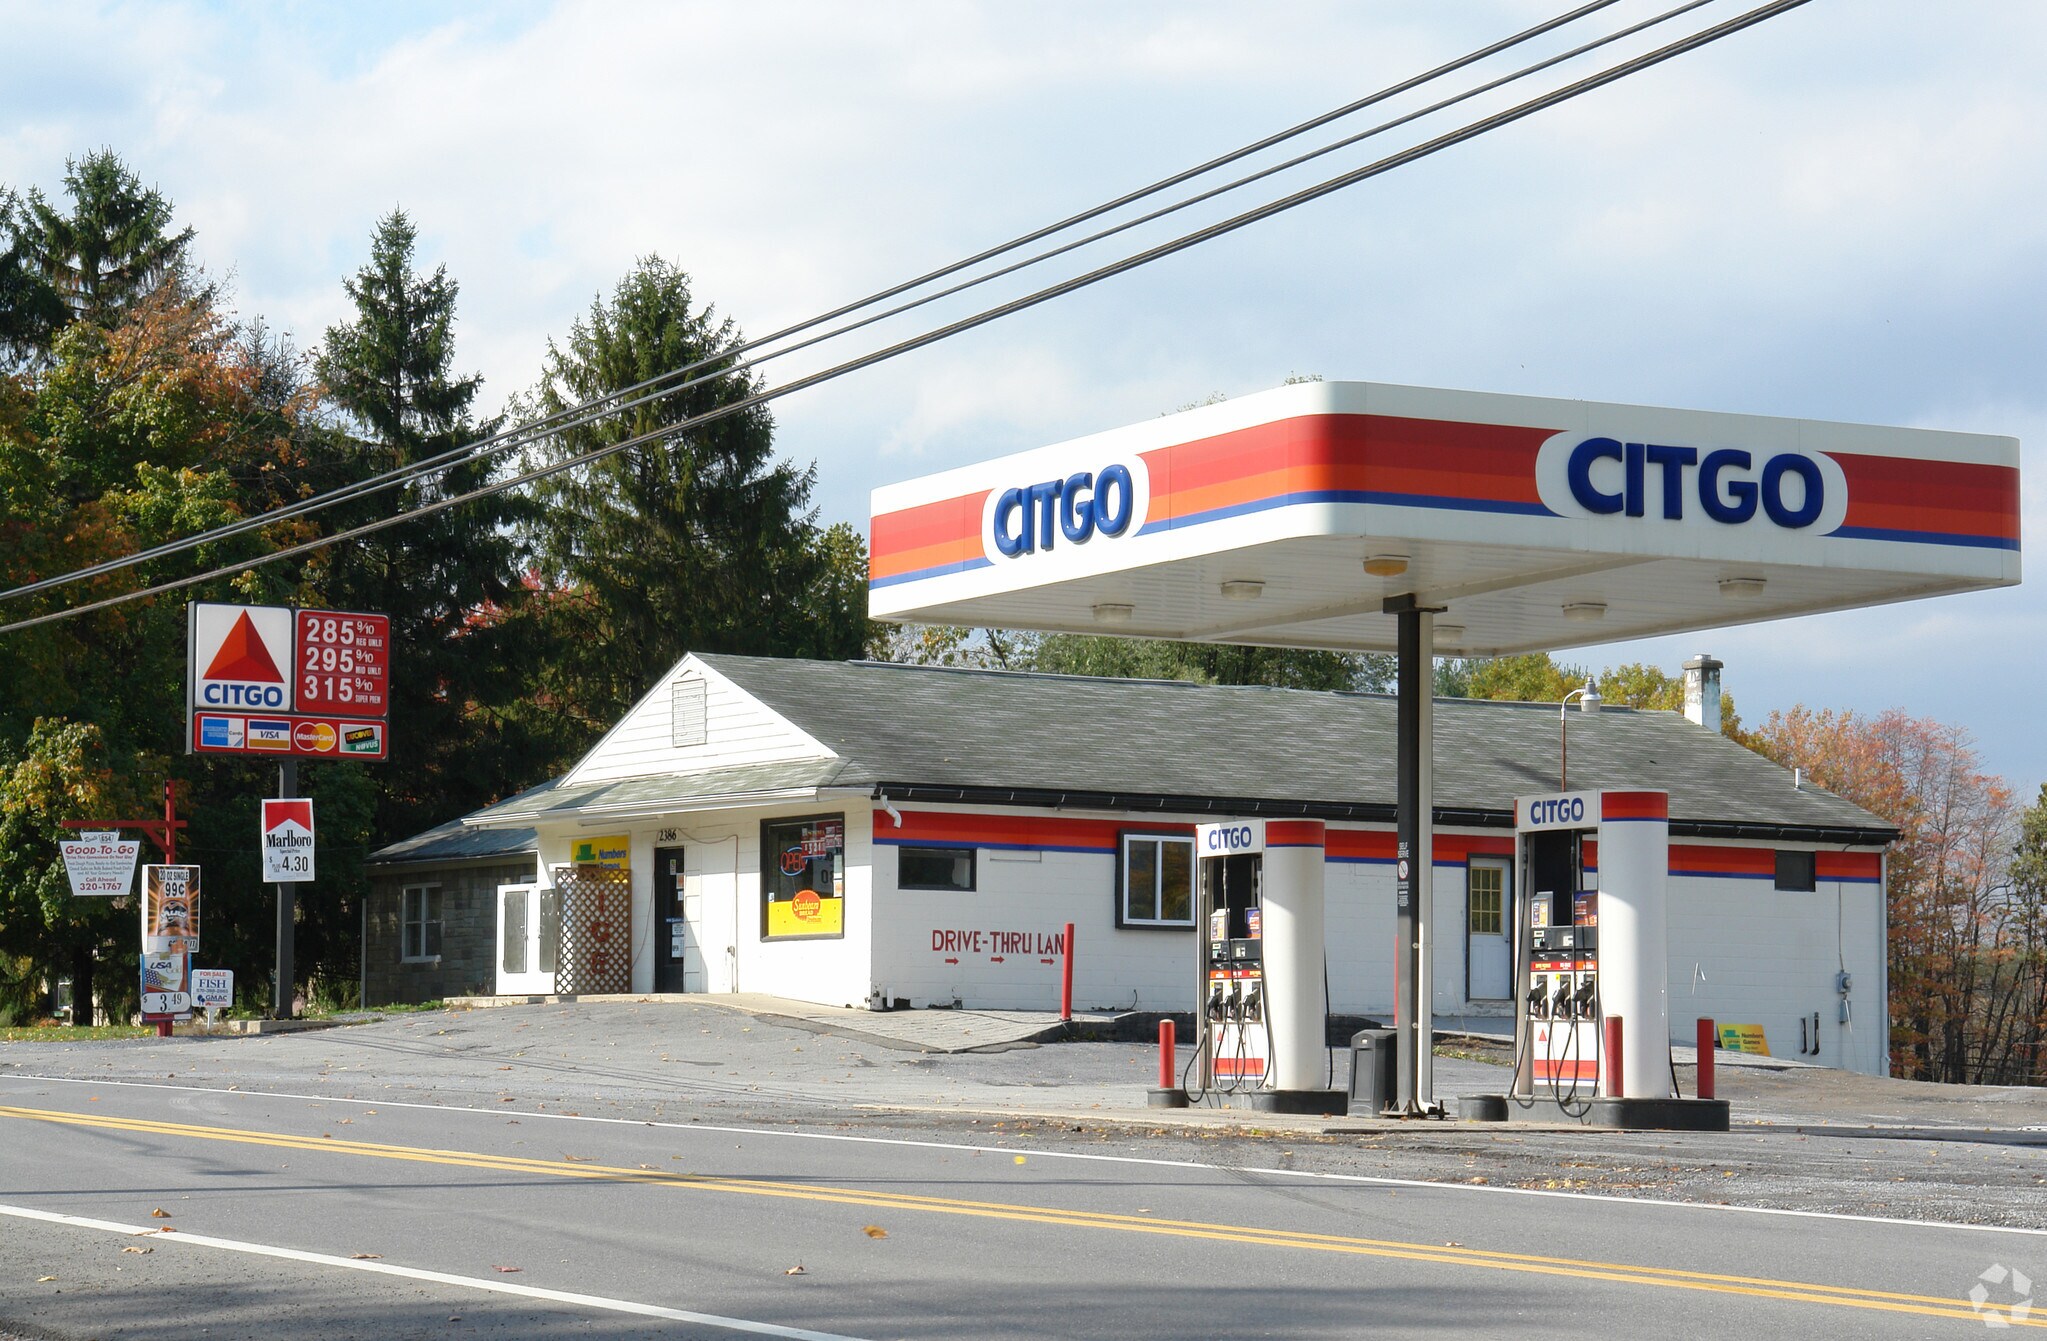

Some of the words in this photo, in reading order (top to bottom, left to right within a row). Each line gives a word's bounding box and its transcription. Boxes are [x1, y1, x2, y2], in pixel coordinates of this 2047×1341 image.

[1568, 437, 1824, 529] CITGO
[994, 464, 1133, 559] CITGO
[307, 618, 354, 645] 285
[357, 620, 374, 634] 9/10
[356, 638, 366, 646] REG
[306, 646, 353, 673] 295
[356, 649, 374, 663] 9/10
[204, 683, 283, 707] CITGO
[304, 675, 352, 702] 315
[355, 678, 372, 691] 9/10
[260, 731, 279, 739] VISA
[296, 733, 334, 742] MasterCard
[1530, 797, 1584, 825] CITGO
[266, 830, 312, 848] Marlboro
[659, 829, 677, 841] 2386
[1209, 826, 1251, 850] CITGO
[599, 849, 626, 860] Numbers
[781, 852, 806, 870] OPEN
[282, 856, 308, 872] 4.30
[167, 871, 173, 880] OZ
[174, 871, 189, 880] SINGLE
[932, 930, 1031, 954] DRIVE-THRU
[200, 979, 226, 988] FISH
